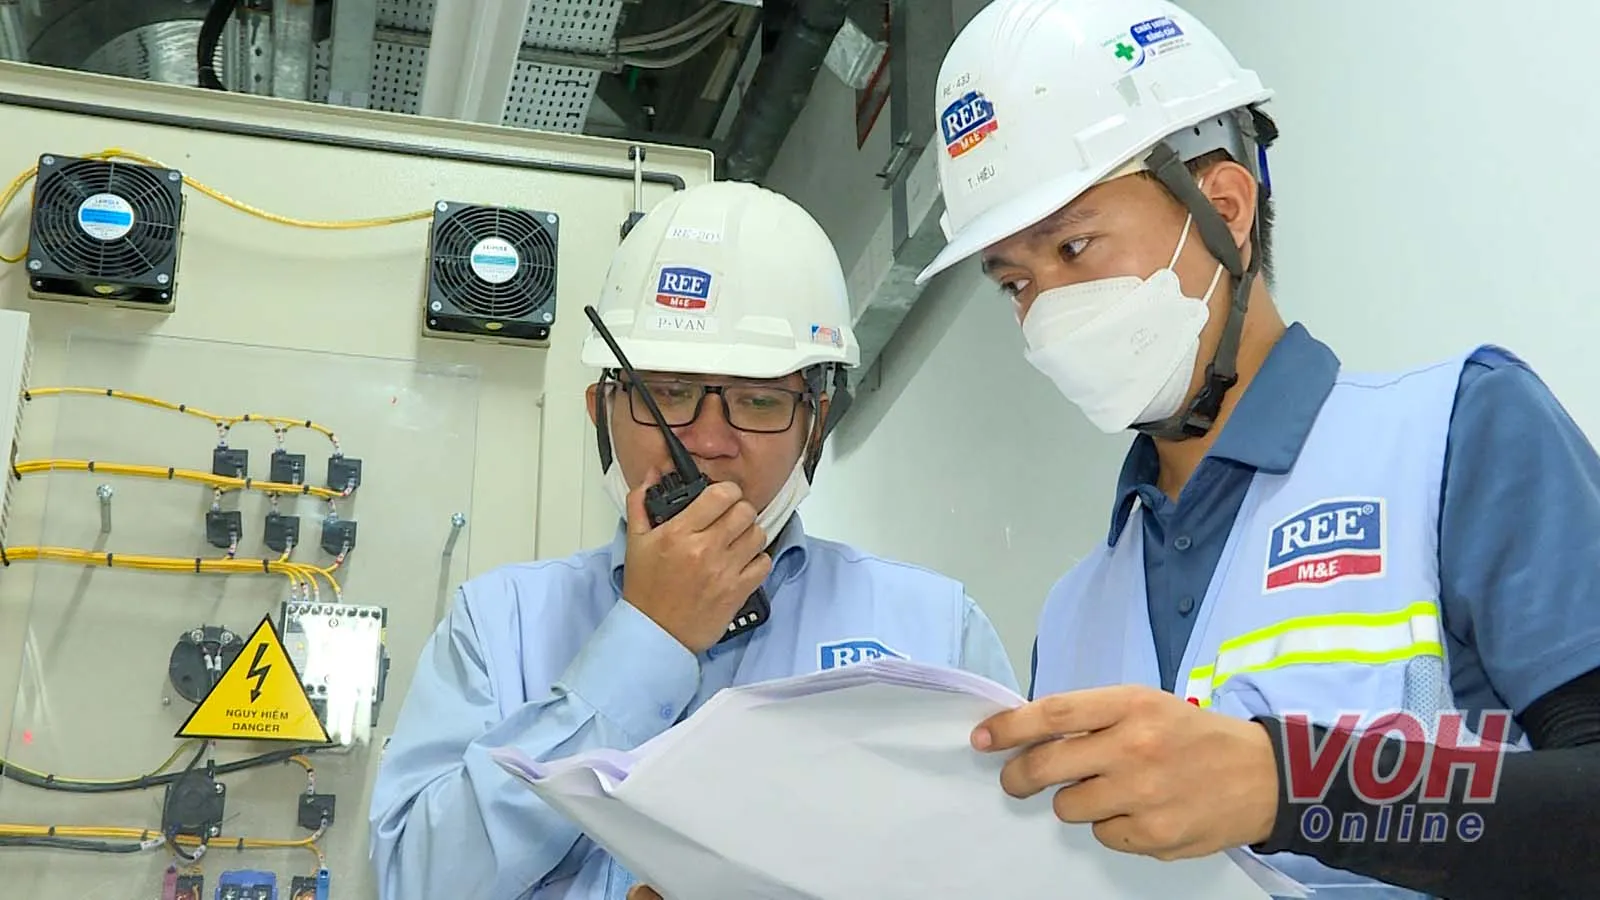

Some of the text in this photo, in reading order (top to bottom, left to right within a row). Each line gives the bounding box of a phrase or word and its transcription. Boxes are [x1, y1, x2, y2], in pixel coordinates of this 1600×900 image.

[945, 96, 988, 138] REE
[959, 130, 982, 150] M&E
[662, 271, 704, 295] REE
[670, 297, 691, 307] M&E
[1278, 505, 1365, 558] REE
[1297, 560, 1340, 580] M&E
[831, 646, 888, 668] RE
[226, 709, 258, 719] NGUY
[232, 722, 280, 733] DANGER
